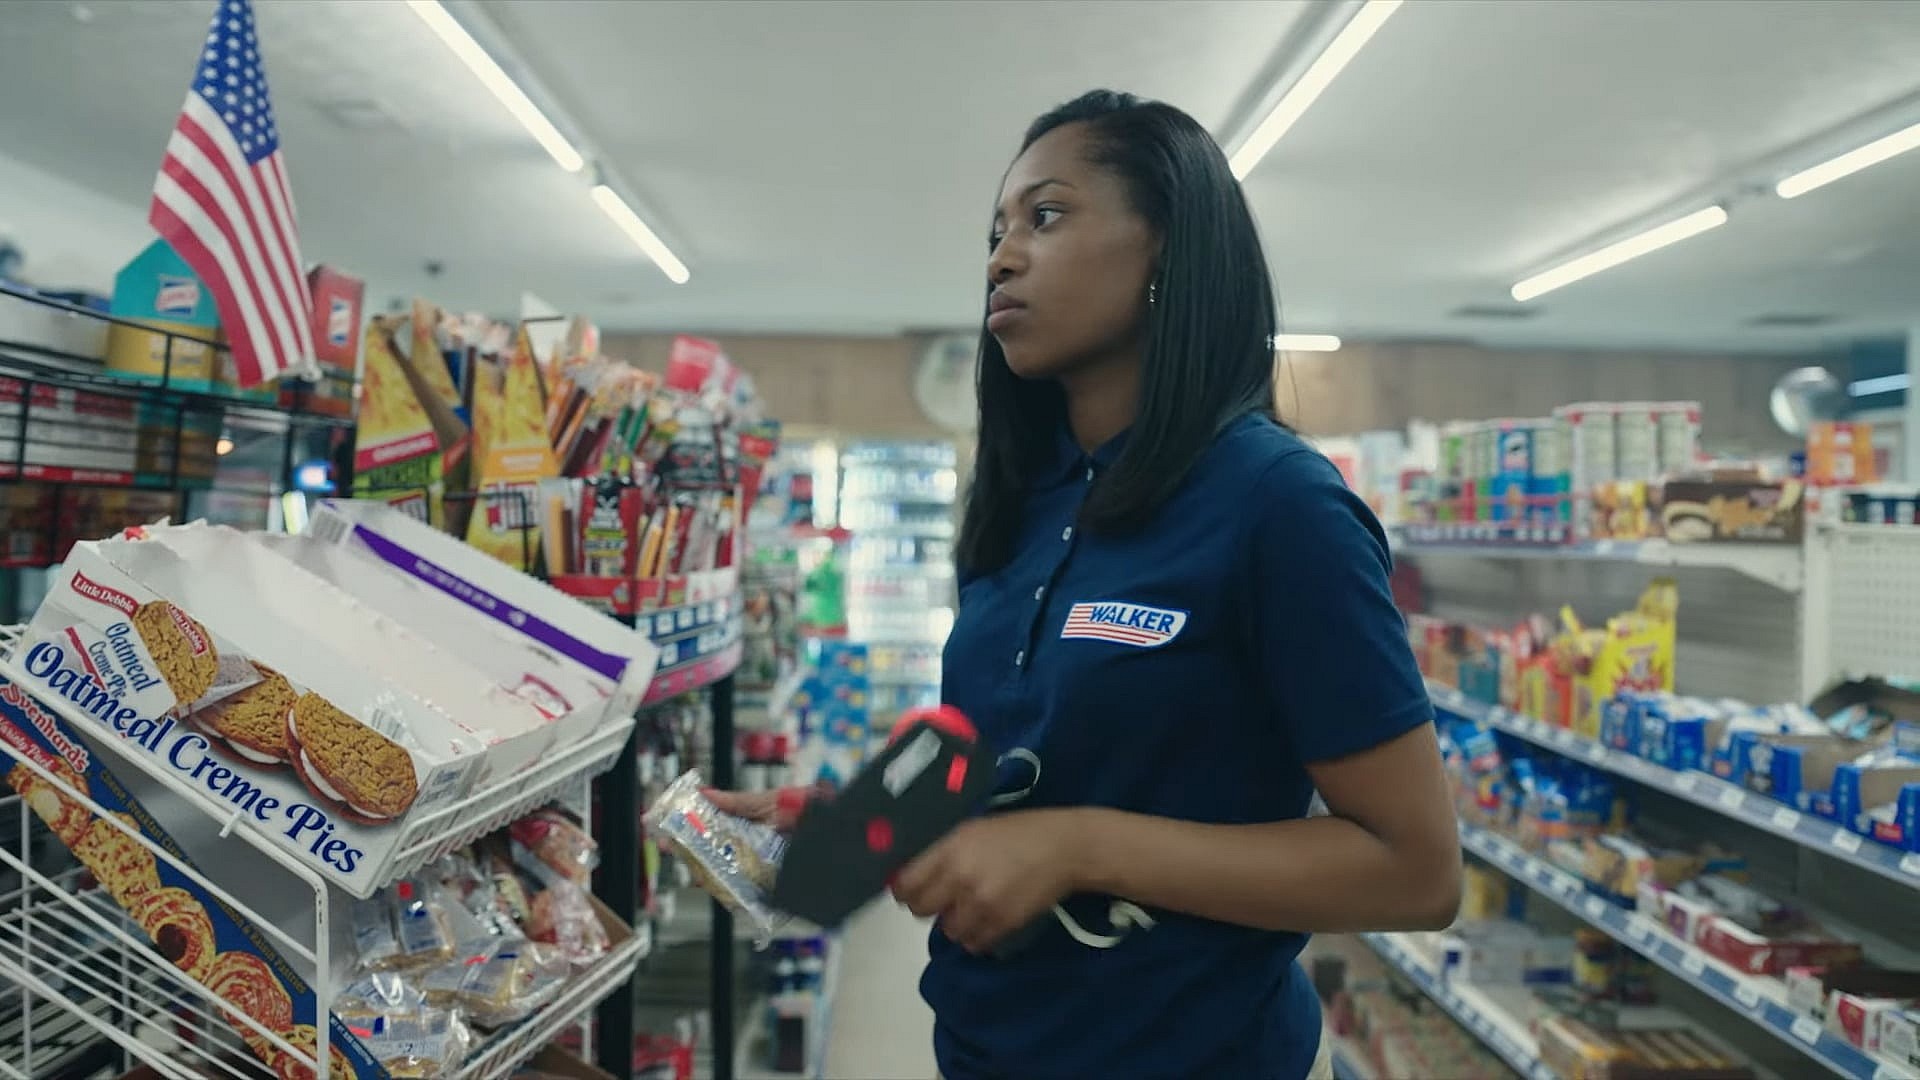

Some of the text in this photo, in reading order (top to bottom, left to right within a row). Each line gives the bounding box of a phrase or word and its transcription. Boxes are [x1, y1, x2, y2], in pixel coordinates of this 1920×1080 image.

[72, 576, 136, 614] Little Debbie
[1089, 605, 1175, 634] WALKER
[89, 640, 128, 699] Creme Pie
[104, 622, 162, 692] Oatmeal
[0, 682, 90, 773] Svenhard's
[25, 640, 364, 874] Oatmeal Creme Pies
